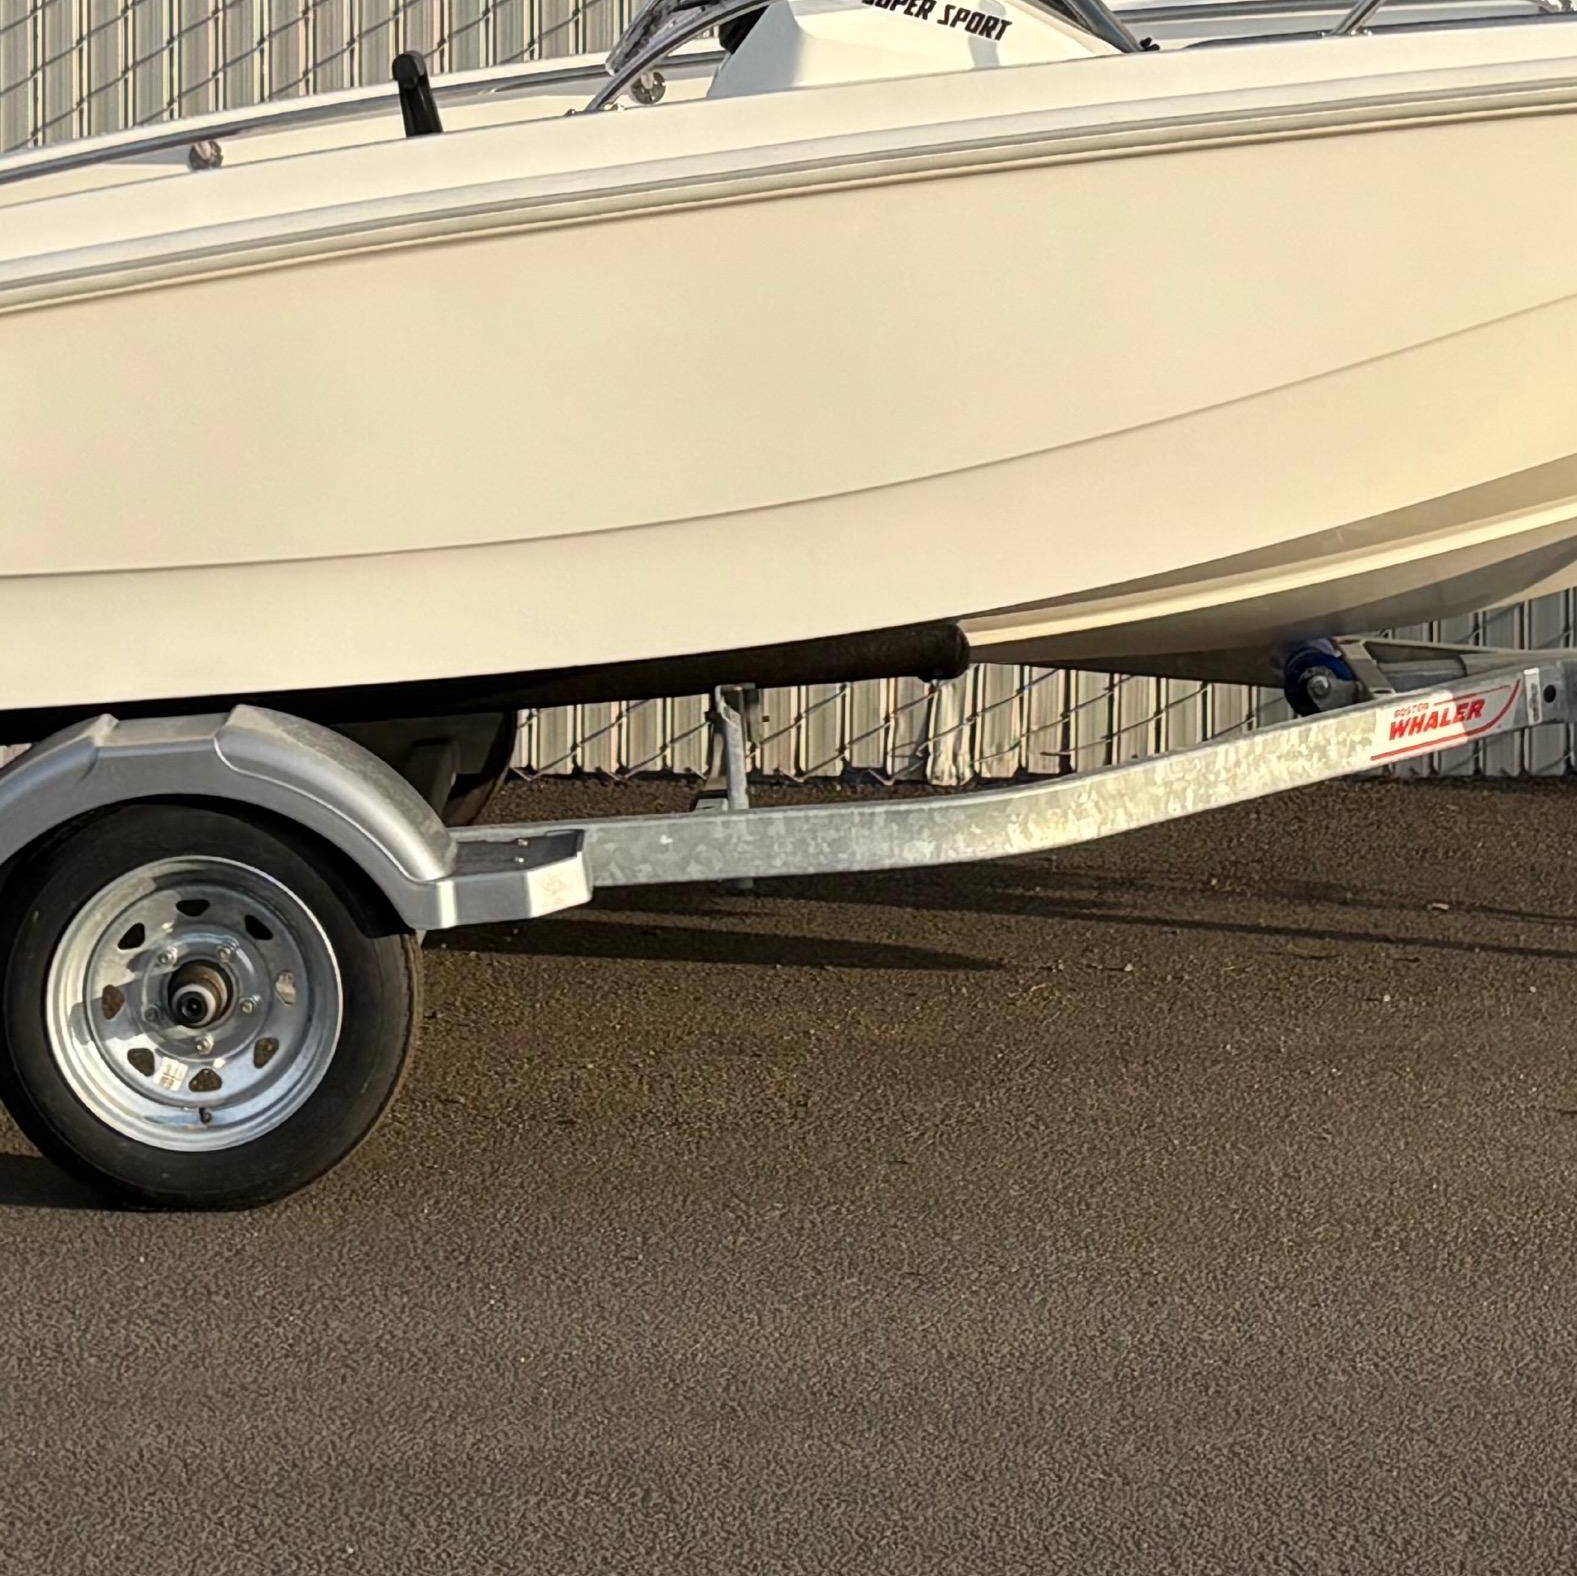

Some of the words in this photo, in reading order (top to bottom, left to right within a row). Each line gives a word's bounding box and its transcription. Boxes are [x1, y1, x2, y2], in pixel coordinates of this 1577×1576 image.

[937, 4, 1012, 41] SPORT
[1389, 698, 1486, 740] WHALER
[1394, 702, 1429, 719] BOSTON
